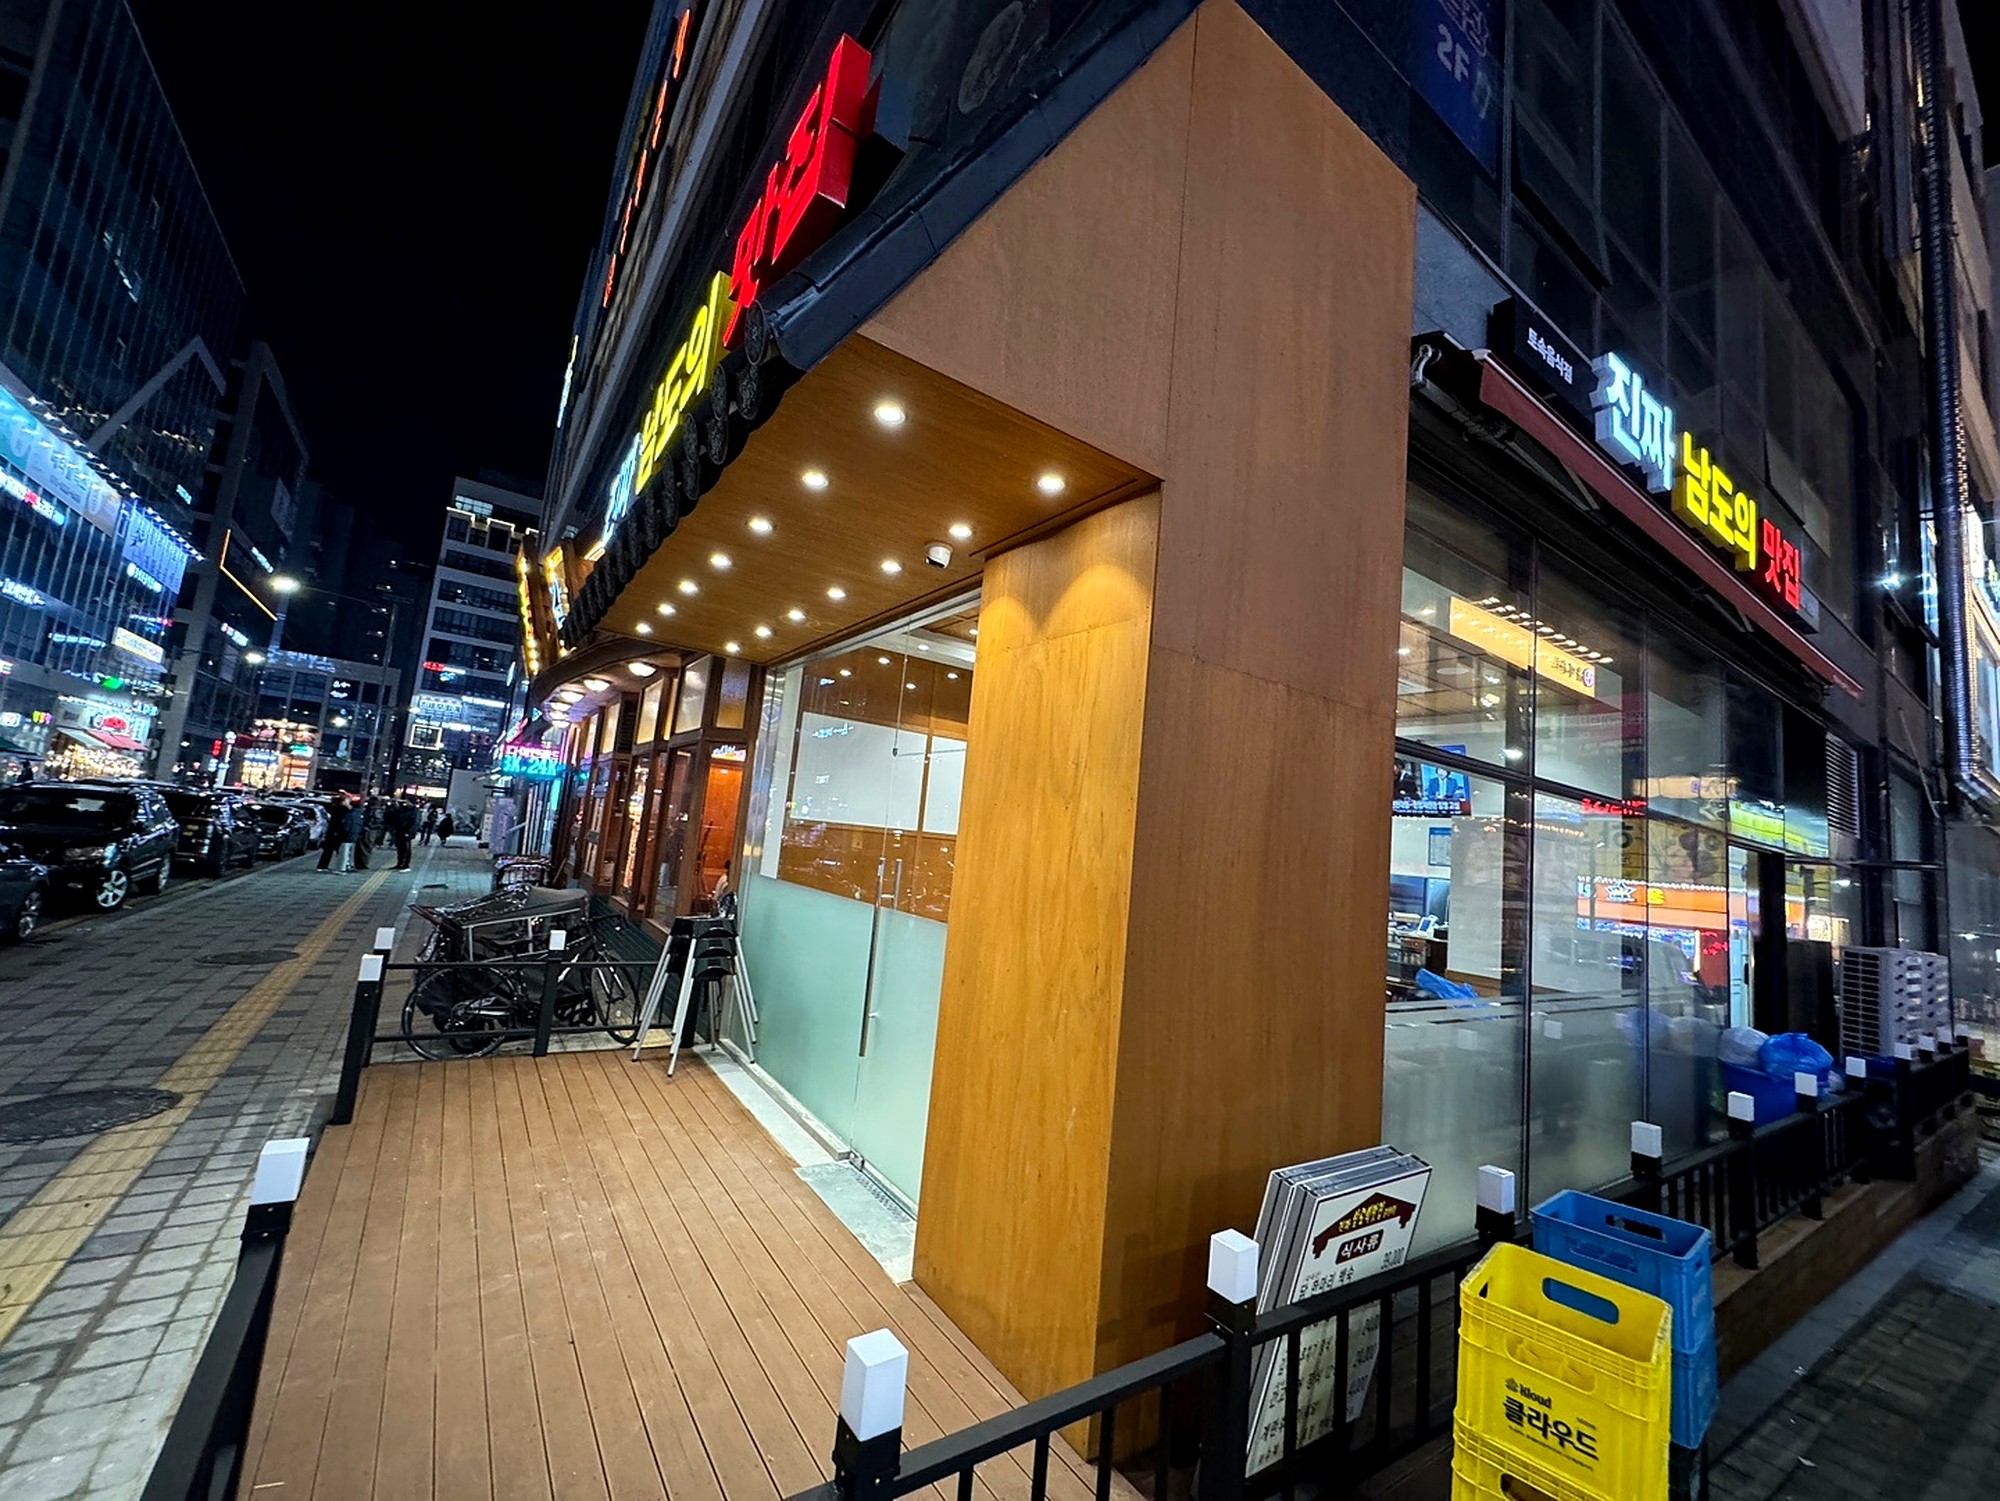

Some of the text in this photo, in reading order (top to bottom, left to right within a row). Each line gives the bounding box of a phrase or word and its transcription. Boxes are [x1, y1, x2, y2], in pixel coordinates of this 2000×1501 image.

[1436, 23, 1470, 83] 2F
[635, 271, 735, 495] 남도의
[722, 33, 851, 348] 맛집
[1527, 327, 1573, 385] 토속음식점
[1591, 351, 1801, 611] 진짜 남도의 맛집
[1341, 1233, 1381, 1259] 식사류
[1503, 1395, 1600, 1461] 클라우드
